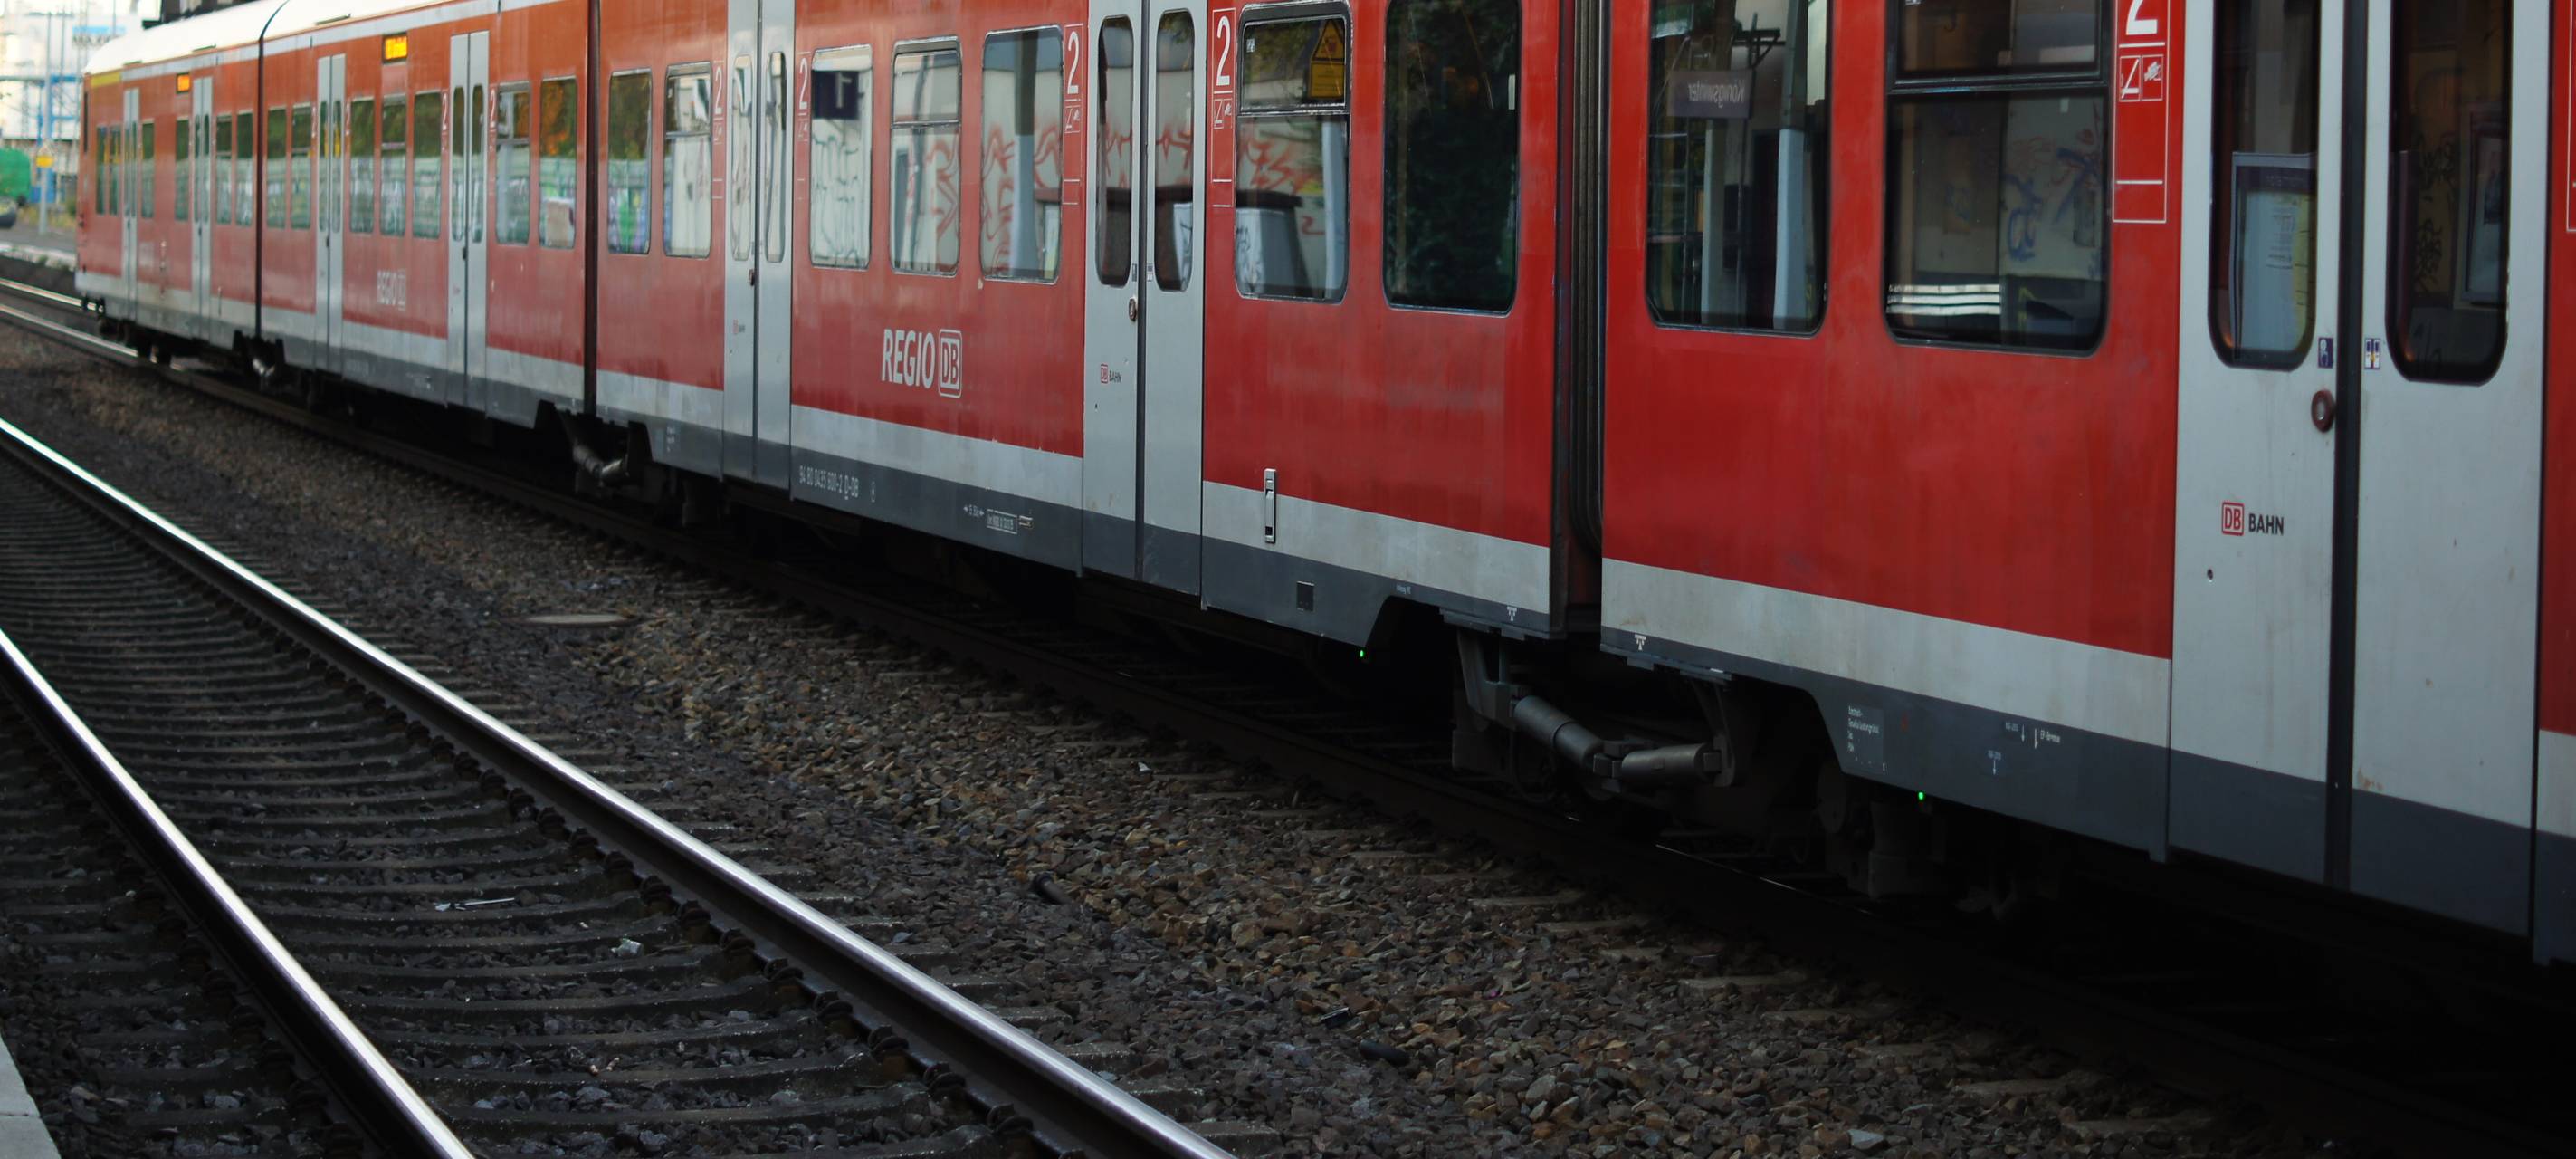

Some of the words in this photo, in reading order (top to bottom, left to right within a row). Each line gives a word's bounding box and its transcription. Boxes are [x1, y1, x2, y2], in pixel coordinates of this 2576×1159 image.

[1067, 31, 1080, 95] 2
[1216, 15, 1231, 86] 2
[714, 66, 722, 115] 2
[799, 58, 808, 110] 2
[881, 328, 936, 389] REGIO
[940, 336, 961, 391] DB
[2224, 505, 2242, 532] DB
[2248, 512, 2284, 536] BAHN
